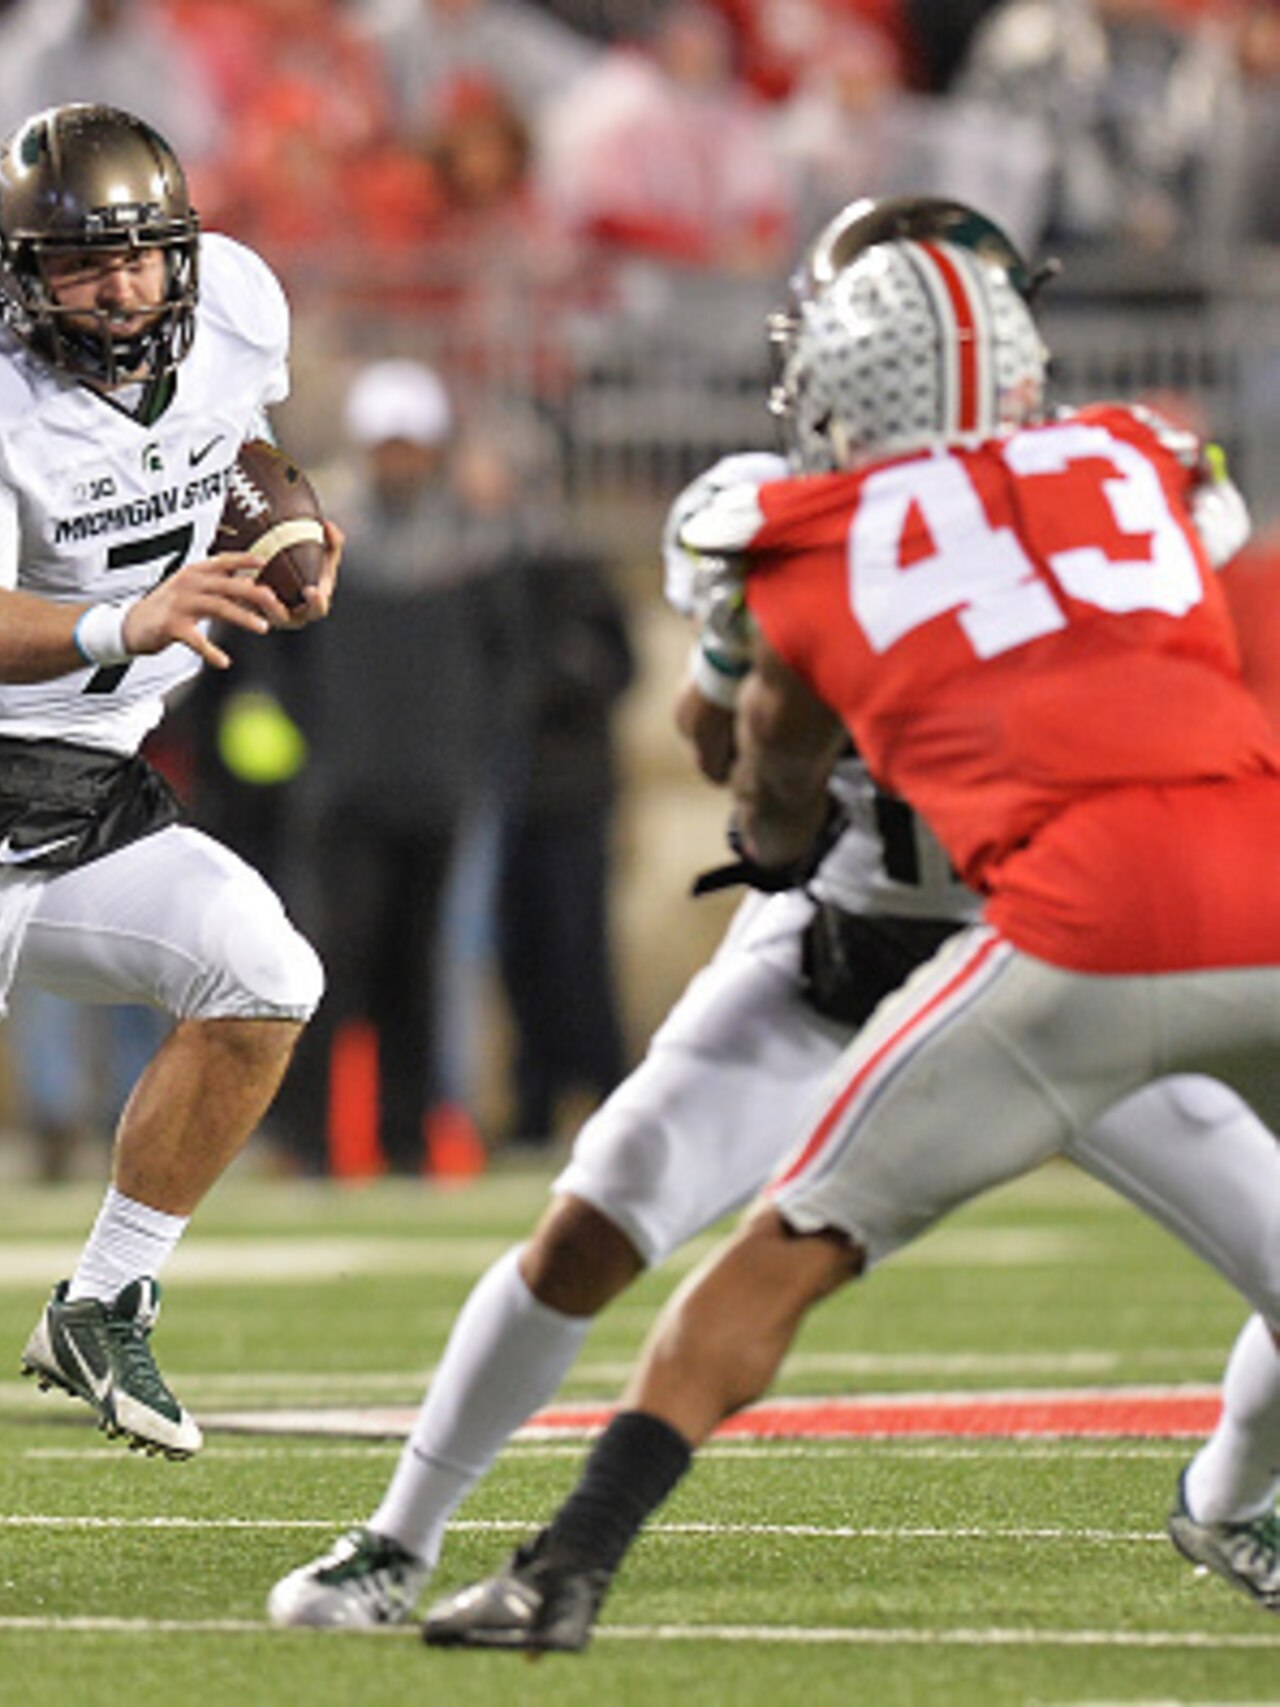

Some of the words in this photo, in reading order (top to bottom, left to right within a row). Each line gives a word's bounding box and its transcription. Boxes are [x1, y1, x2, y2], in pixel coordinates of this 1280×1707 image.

[54, 485, 179, 545] MICHIGAN
[847, 424, 1204, 661] 43
[82, 521, 195, 695] 7
